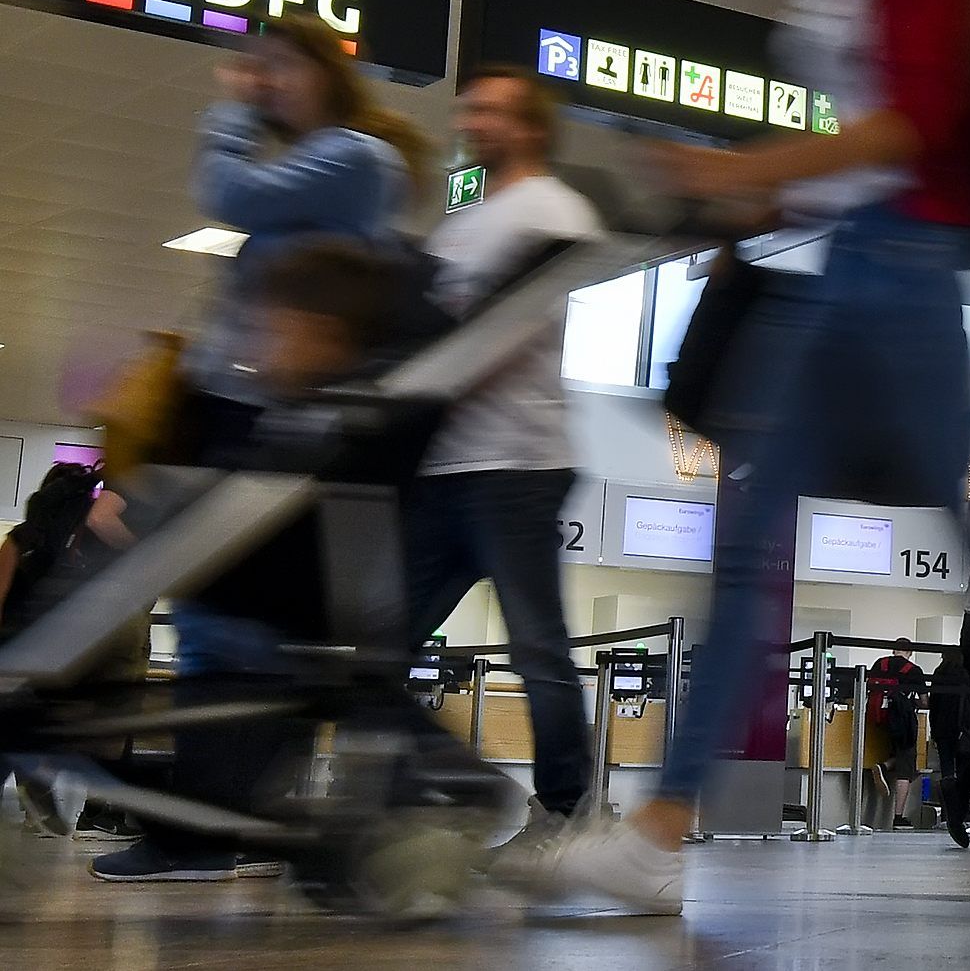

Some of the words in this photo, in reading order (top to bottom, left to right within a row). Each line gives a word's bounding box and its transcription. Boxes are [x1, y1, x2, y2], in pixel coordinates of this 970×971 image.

[591, 43, 605, 52] TAX
[608, 46, 627, 58] FREE
[900, 549, 950, 579] 154
